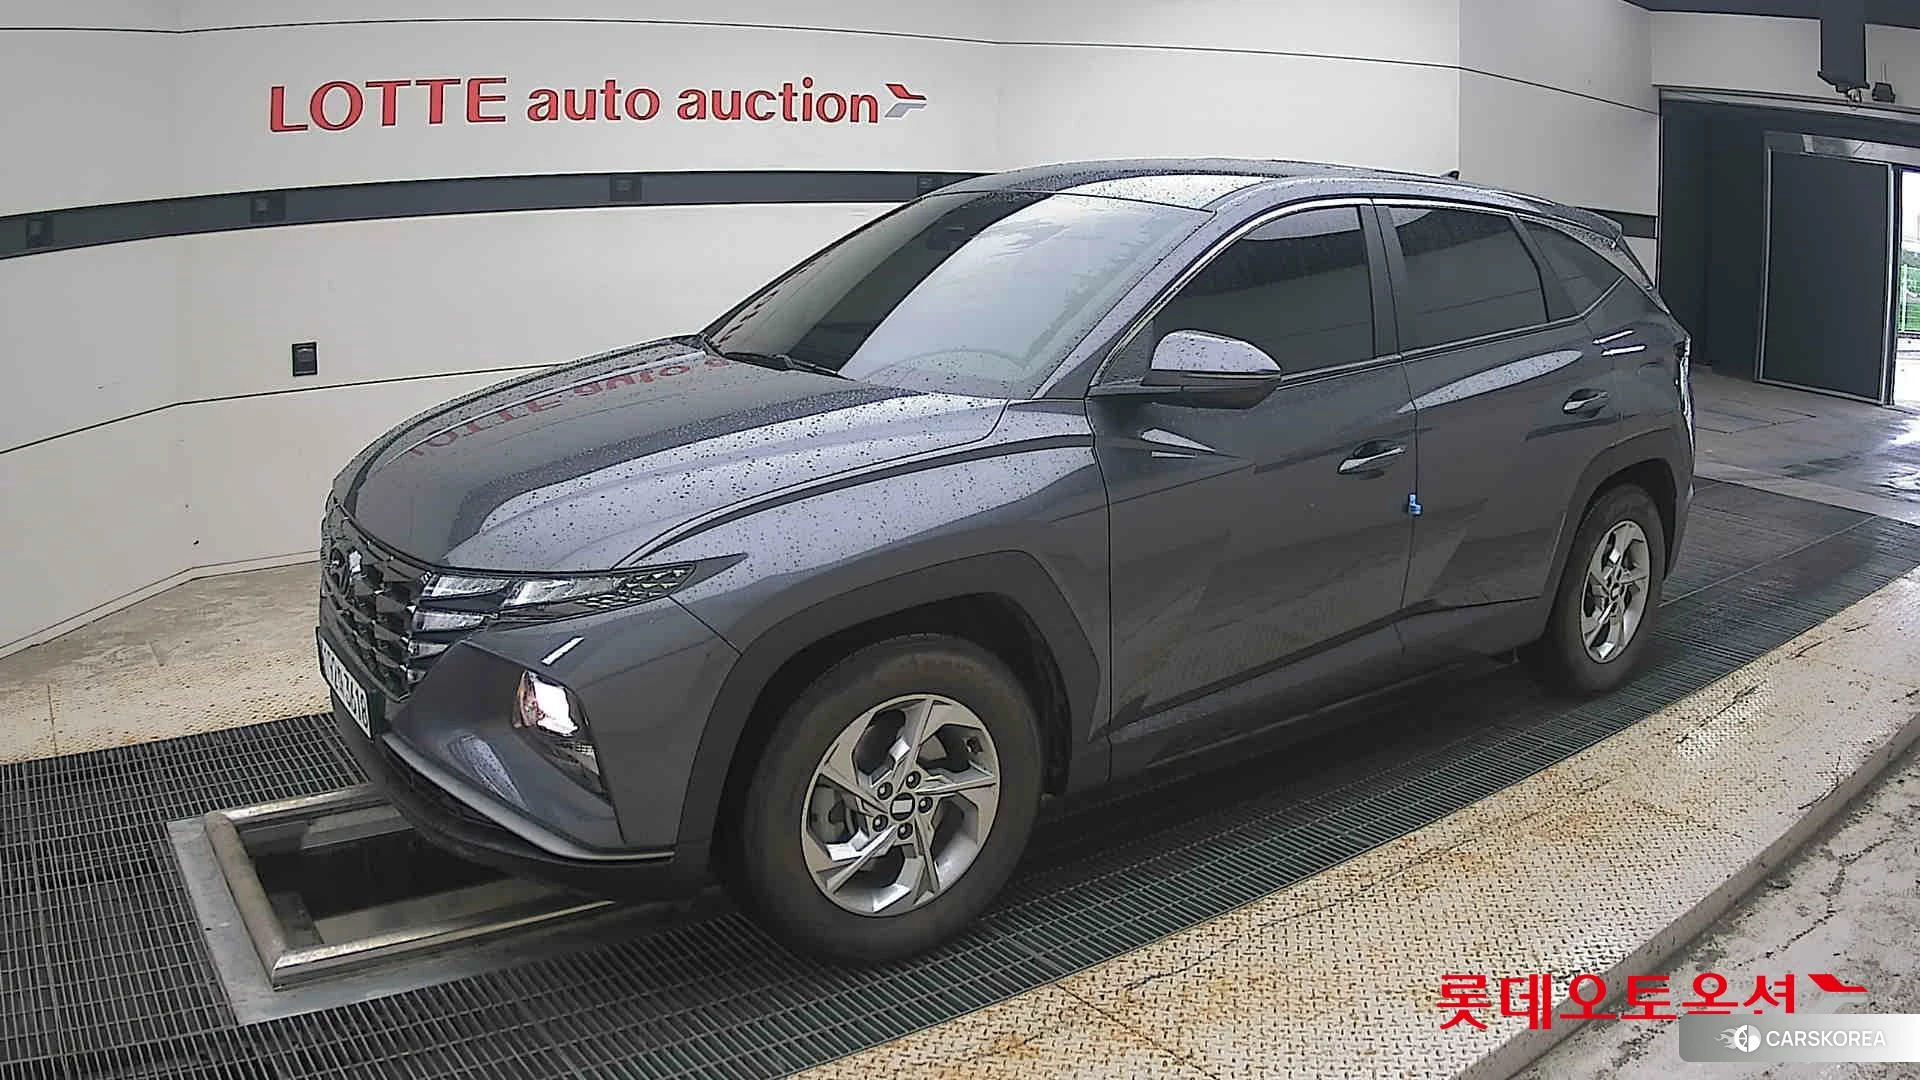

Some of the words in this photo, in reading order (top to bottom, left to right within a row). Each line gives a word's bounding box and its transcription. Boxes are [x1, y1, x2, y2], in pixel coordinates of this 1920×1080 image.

[270, 77, 507, 132] LOTTE
[527, 80, 661, 121] auto
[677, 78, 879, 123] auction
